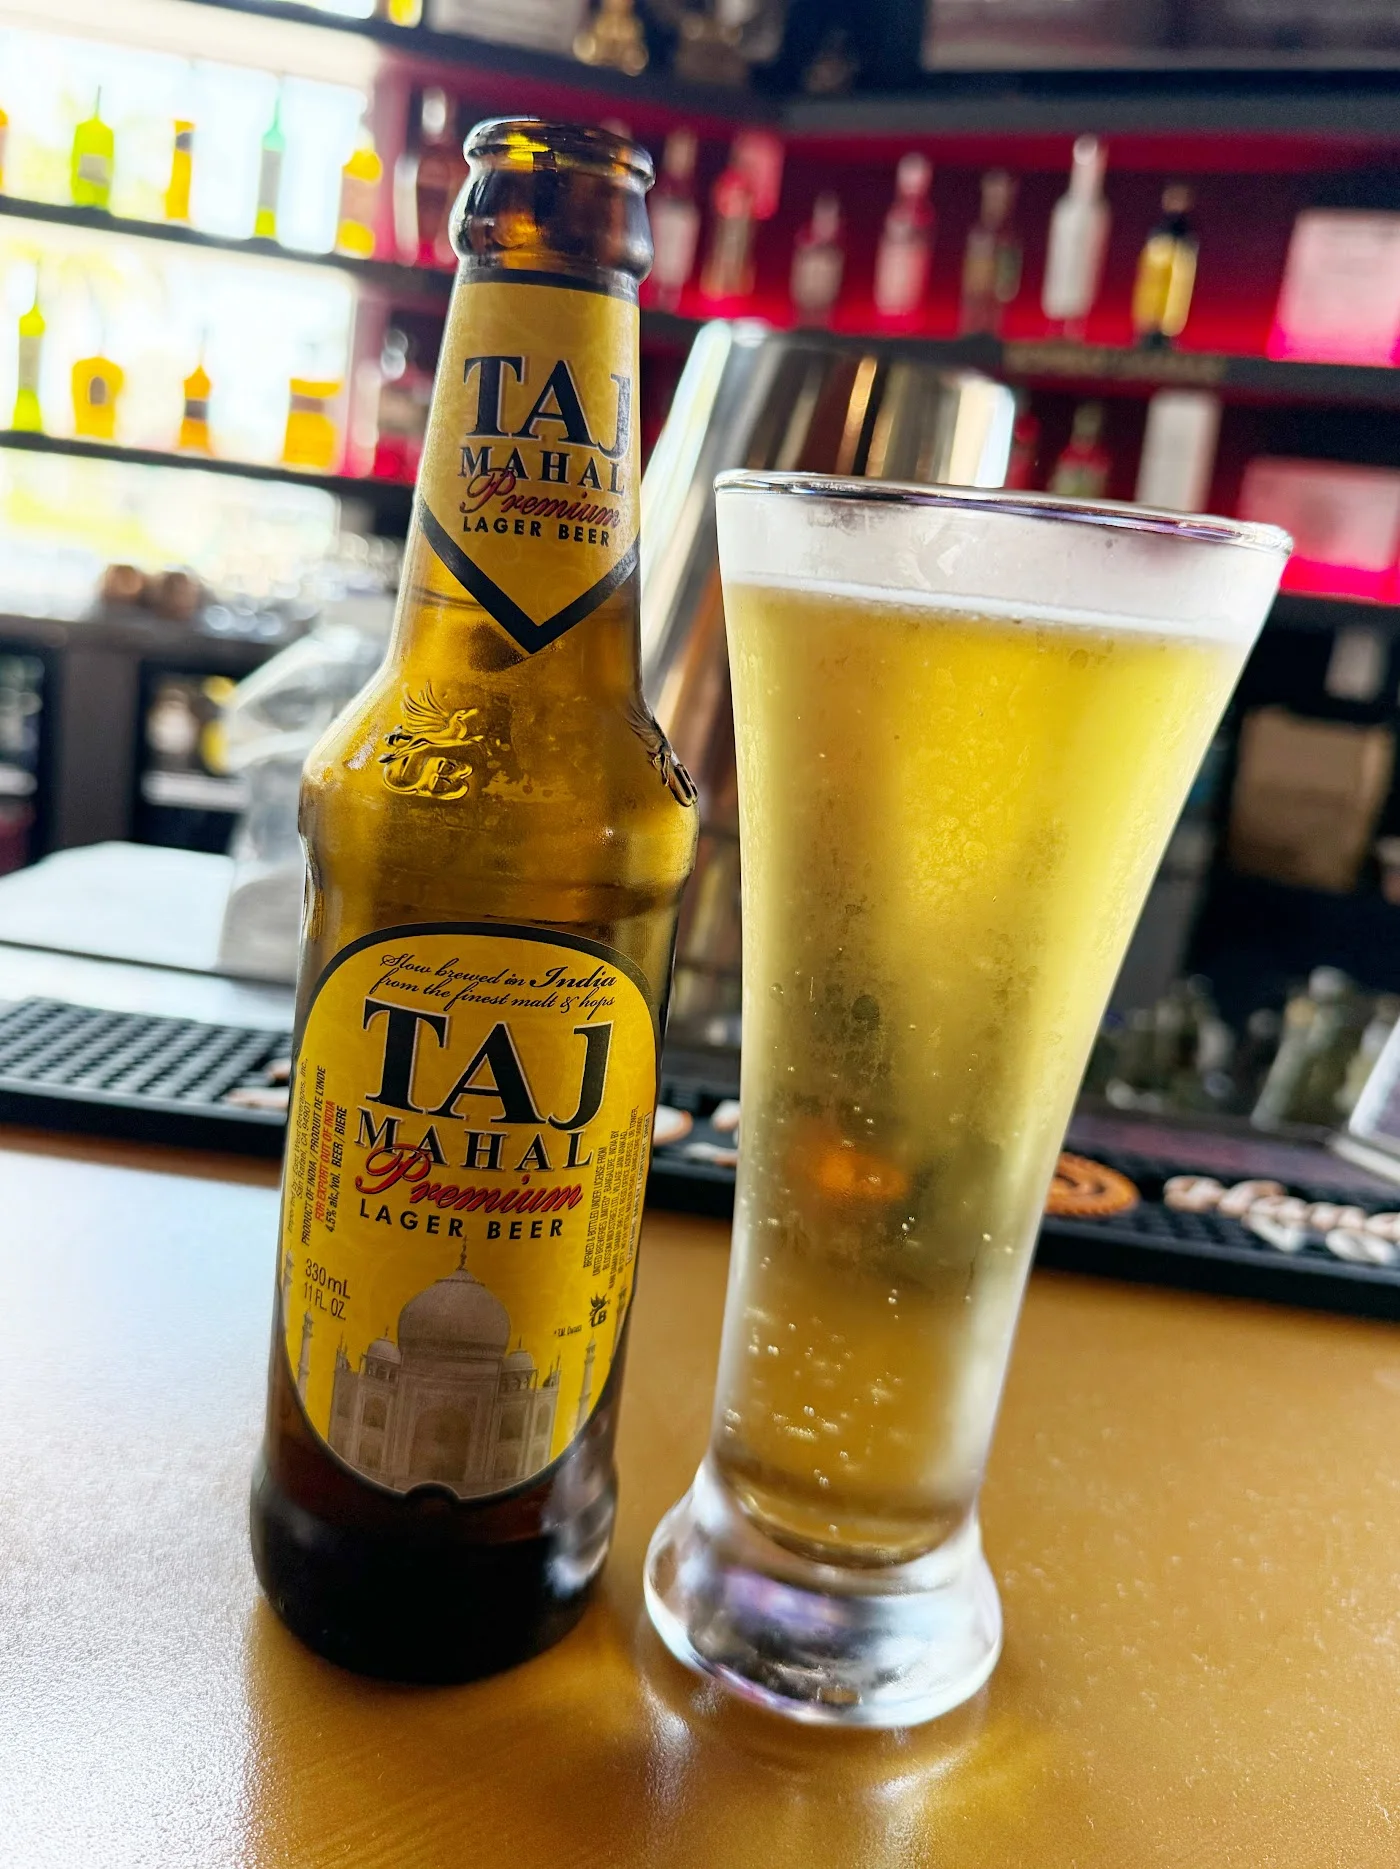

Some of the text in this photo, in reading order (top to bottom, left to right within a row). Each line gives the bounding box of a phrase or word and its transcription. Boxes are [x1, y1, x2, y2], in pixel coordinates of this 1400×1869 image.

[464, 356, 631, 460] TAJ
[458, 447, 625, 496] MAHAL
[460, 467, 620, 528] Premium
[463, 516, 609, 547] LAGER BEER
[369, 967, 616, 1020] from the finest malt & hops
[380, 953, 618, 989] Slow brewed in India
[315, 1065, 325, 1096] L'INDE
[362, 1000, 613, 1131] TAJ
[313, 1096, 322, 1110] DE
[295, 1100, 310, 1198] San Rafael, CA 94901
[309, 1110, 321, 1153] PRODUIT
[354, 1106, 594, 1172] MAHAL
[306, 1160, 316, 1186] INDIA
[314, 1100, 334, 1221] FOR EXPORT OUT OF INDIA
[355, 1144, 583, 1214] Premium
[305, 1185, 314, 1200] OF
[323, 1208, 336, 1233] 4.5%
[331, 1141, 343, 1167] BEER
[300, 1199, 312, 1246] PRODUCT
[360, 1198, 564, 1240] LAGER BEER
[304, 1282, 313, 1302] 11
